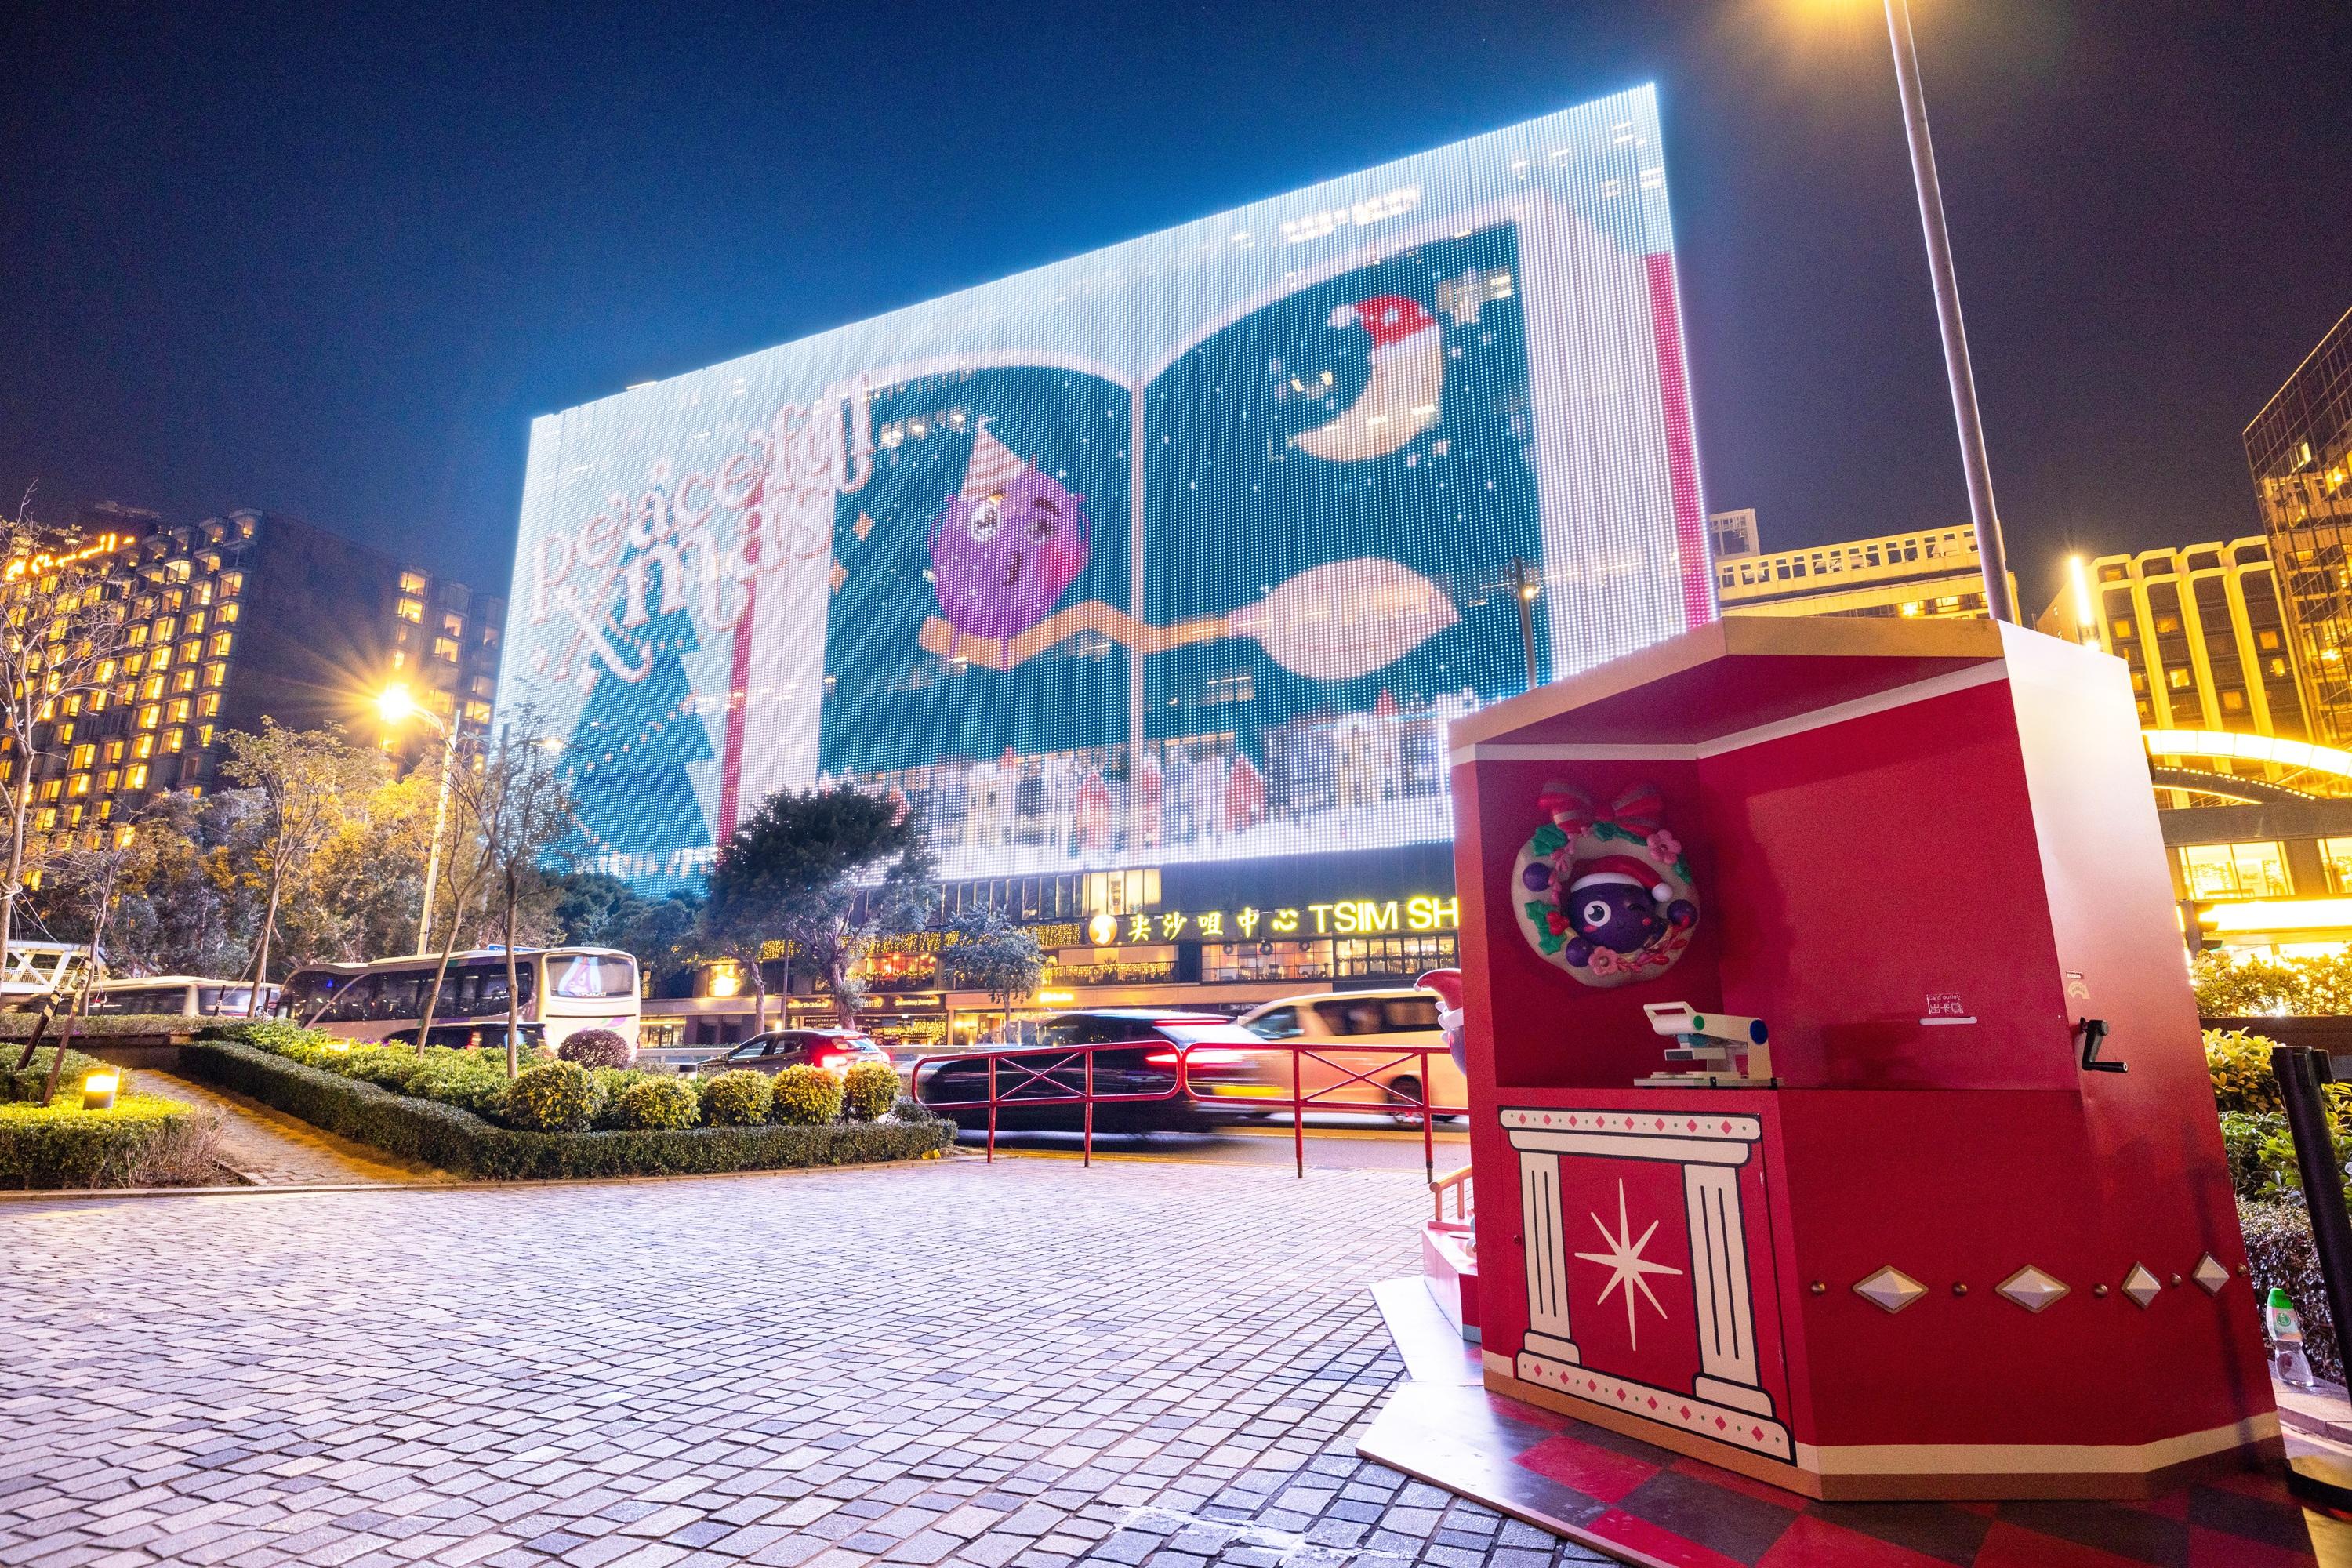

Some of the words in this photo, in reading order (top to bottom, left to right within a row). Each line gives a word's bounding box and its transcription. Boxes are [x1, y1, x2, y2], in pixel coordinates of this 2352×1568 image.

[1127, 907, 1299, 942] 尖沙咀中心
[1308, 901, 1399, 934] TSIM
[1407, 897, 1459, 930] SH
